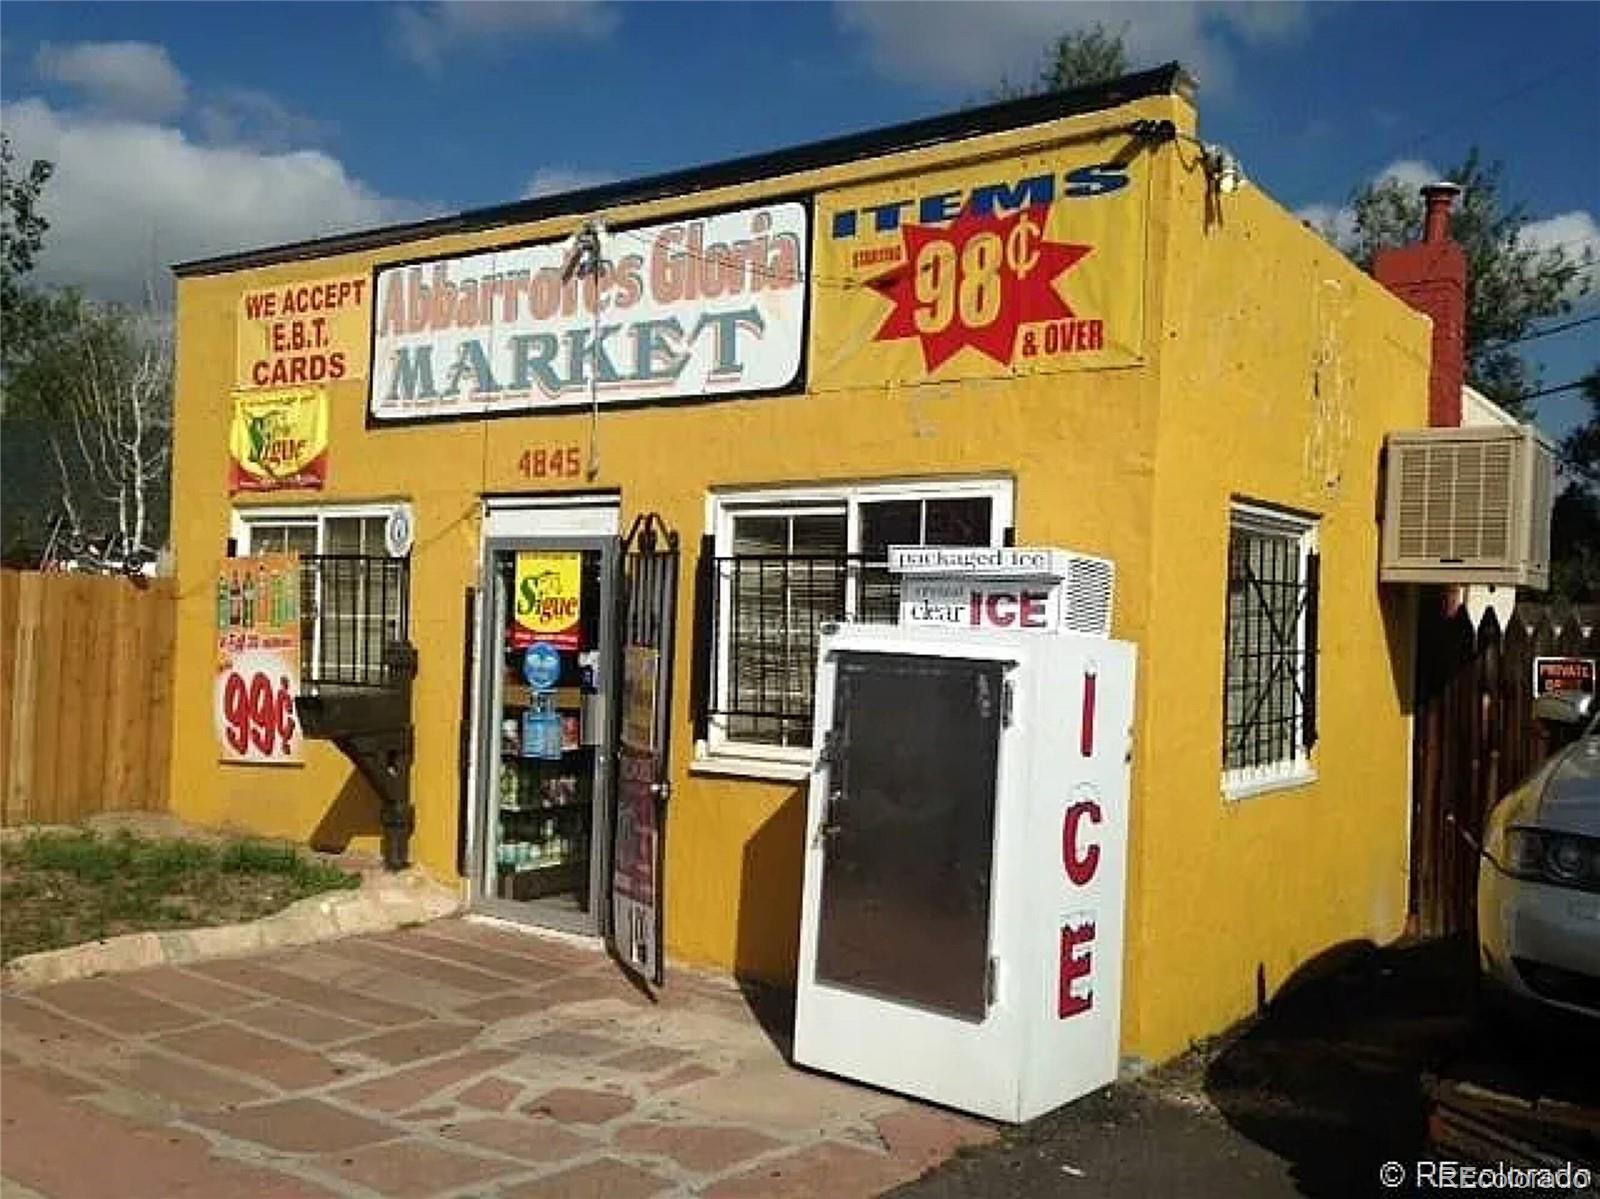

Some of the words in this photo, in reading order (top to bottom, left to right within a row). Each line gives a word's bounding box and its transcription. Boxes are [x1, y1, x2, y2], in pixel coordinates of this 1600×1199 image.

[832, 164, 1131, 241] ITEMS
[650, 211, 802, 306] Gloria
[246, 292, 277, 320] WE
[282, 279, 366, 315] ACCEPT
[272, 317, 329, 353] E.B.T.
[388, 304, 767, 402] MARKET
[1022, 331, 1041, 358] &
[1044, 319, 1104, 356] OVER
[252, 352, 346, 386] CARDS
[518, 447, 581, 479] 4845
[899, 548, 1002, 571] packaged
[1012, 550, 1045, 567] ice
[517, 575, 579, 625] Sigue
[911, 598, 966, 623] clear
[969, 590, 1049, 629] ICE
[224, 672, 296, 757] 99¢
[1057, 668, 1102, 1021] ICE
